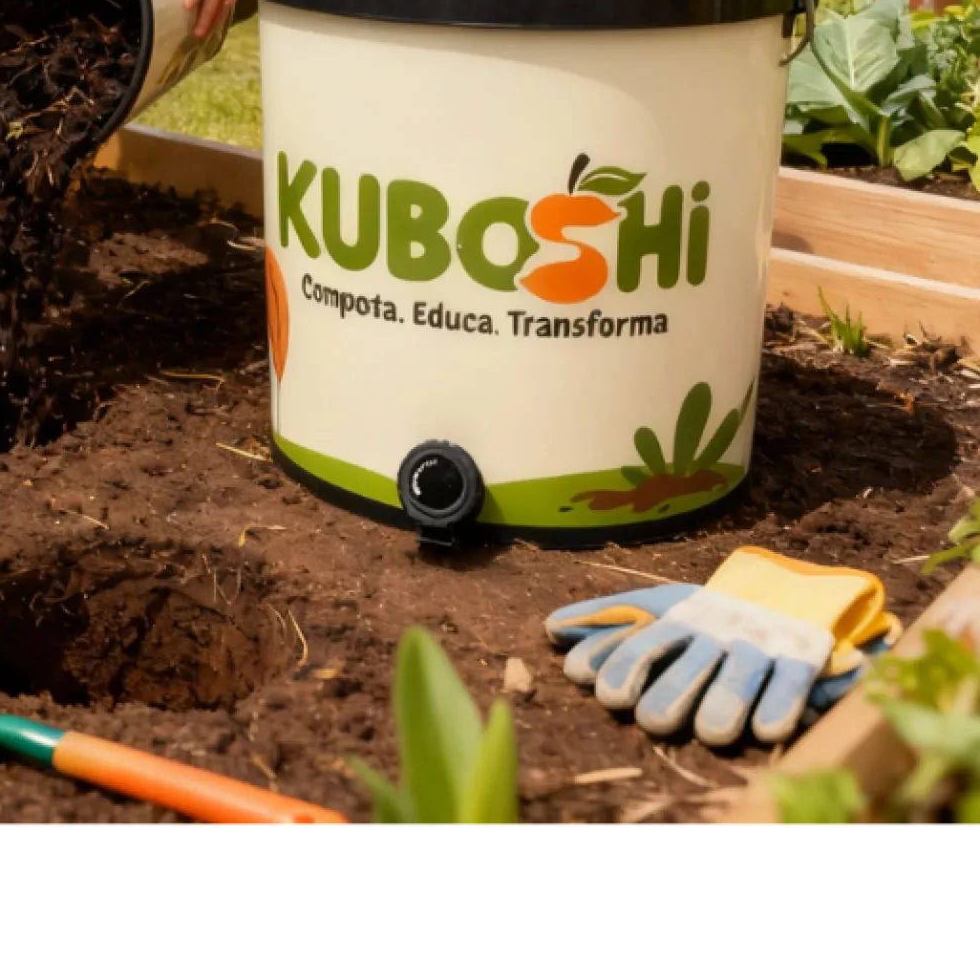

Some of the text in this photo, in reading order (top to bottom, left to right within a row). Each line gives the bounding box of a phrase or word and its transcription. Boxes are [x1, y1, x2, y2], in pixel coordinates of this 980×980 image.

[301, 274, 669, 339] Compota. Educa. Transforma
